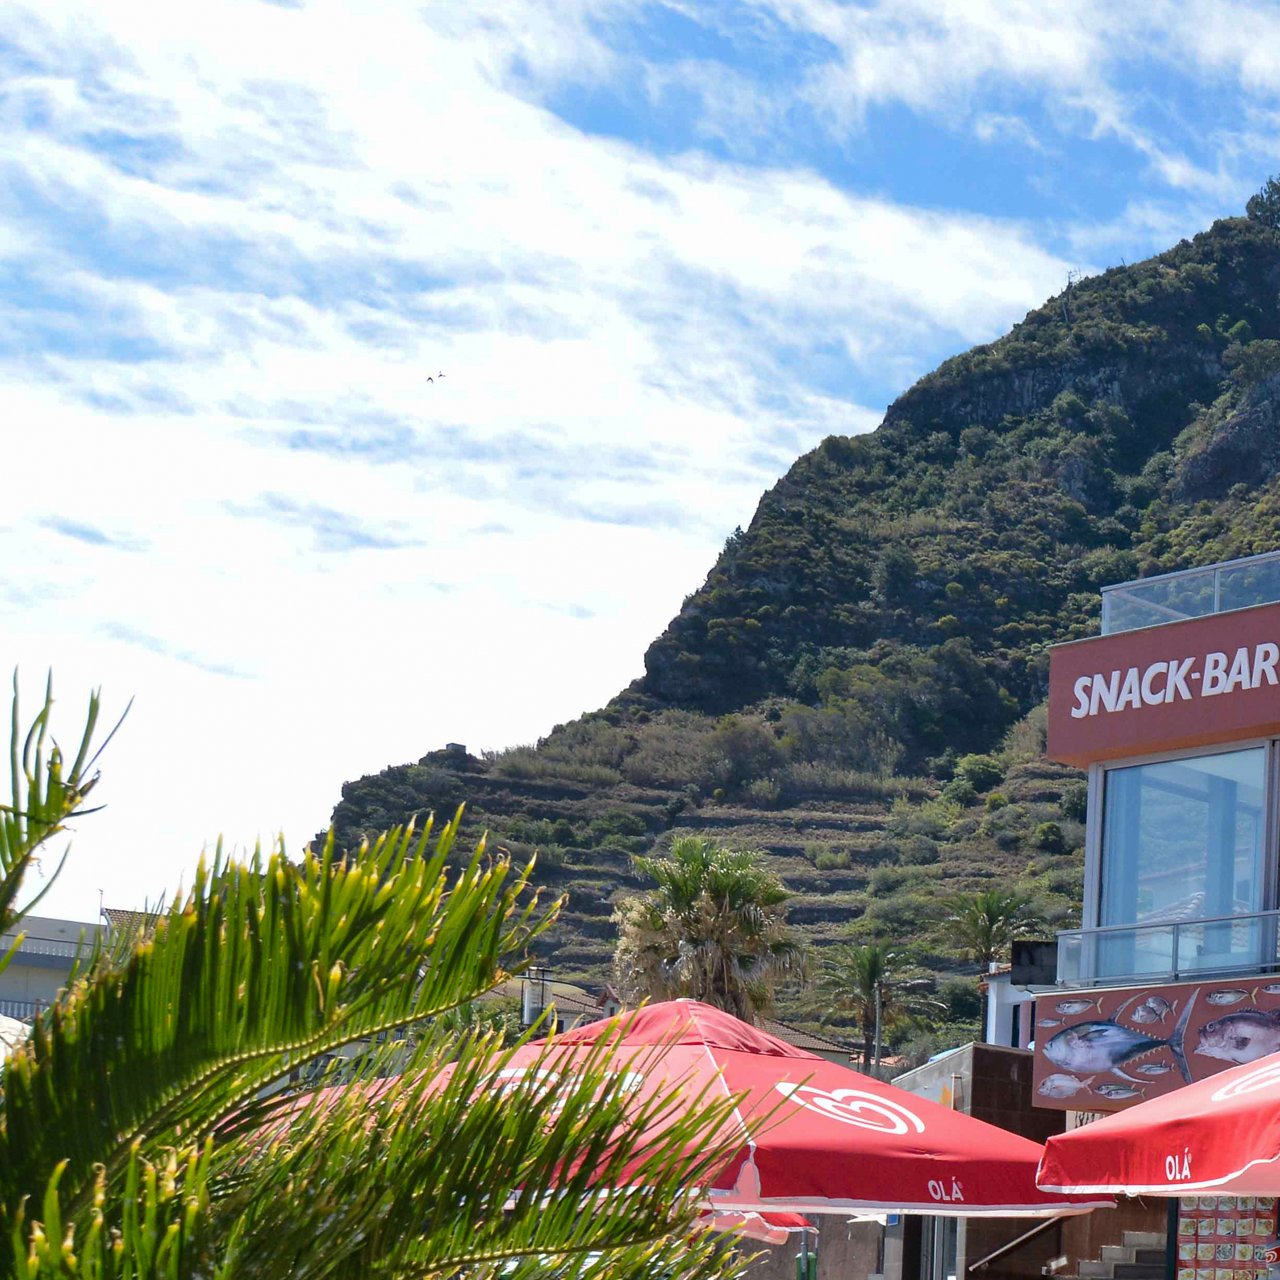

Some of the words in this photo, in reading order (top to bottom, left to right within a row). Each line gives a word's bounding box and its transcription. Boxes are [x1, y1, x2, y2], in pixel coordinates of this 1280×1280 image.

[1070, 642, 1280, 720] SNACK-BAR
[1165, 1146, 1192, 1181] OLÁ
[927, 1175, 965, 1202] OLÁ
